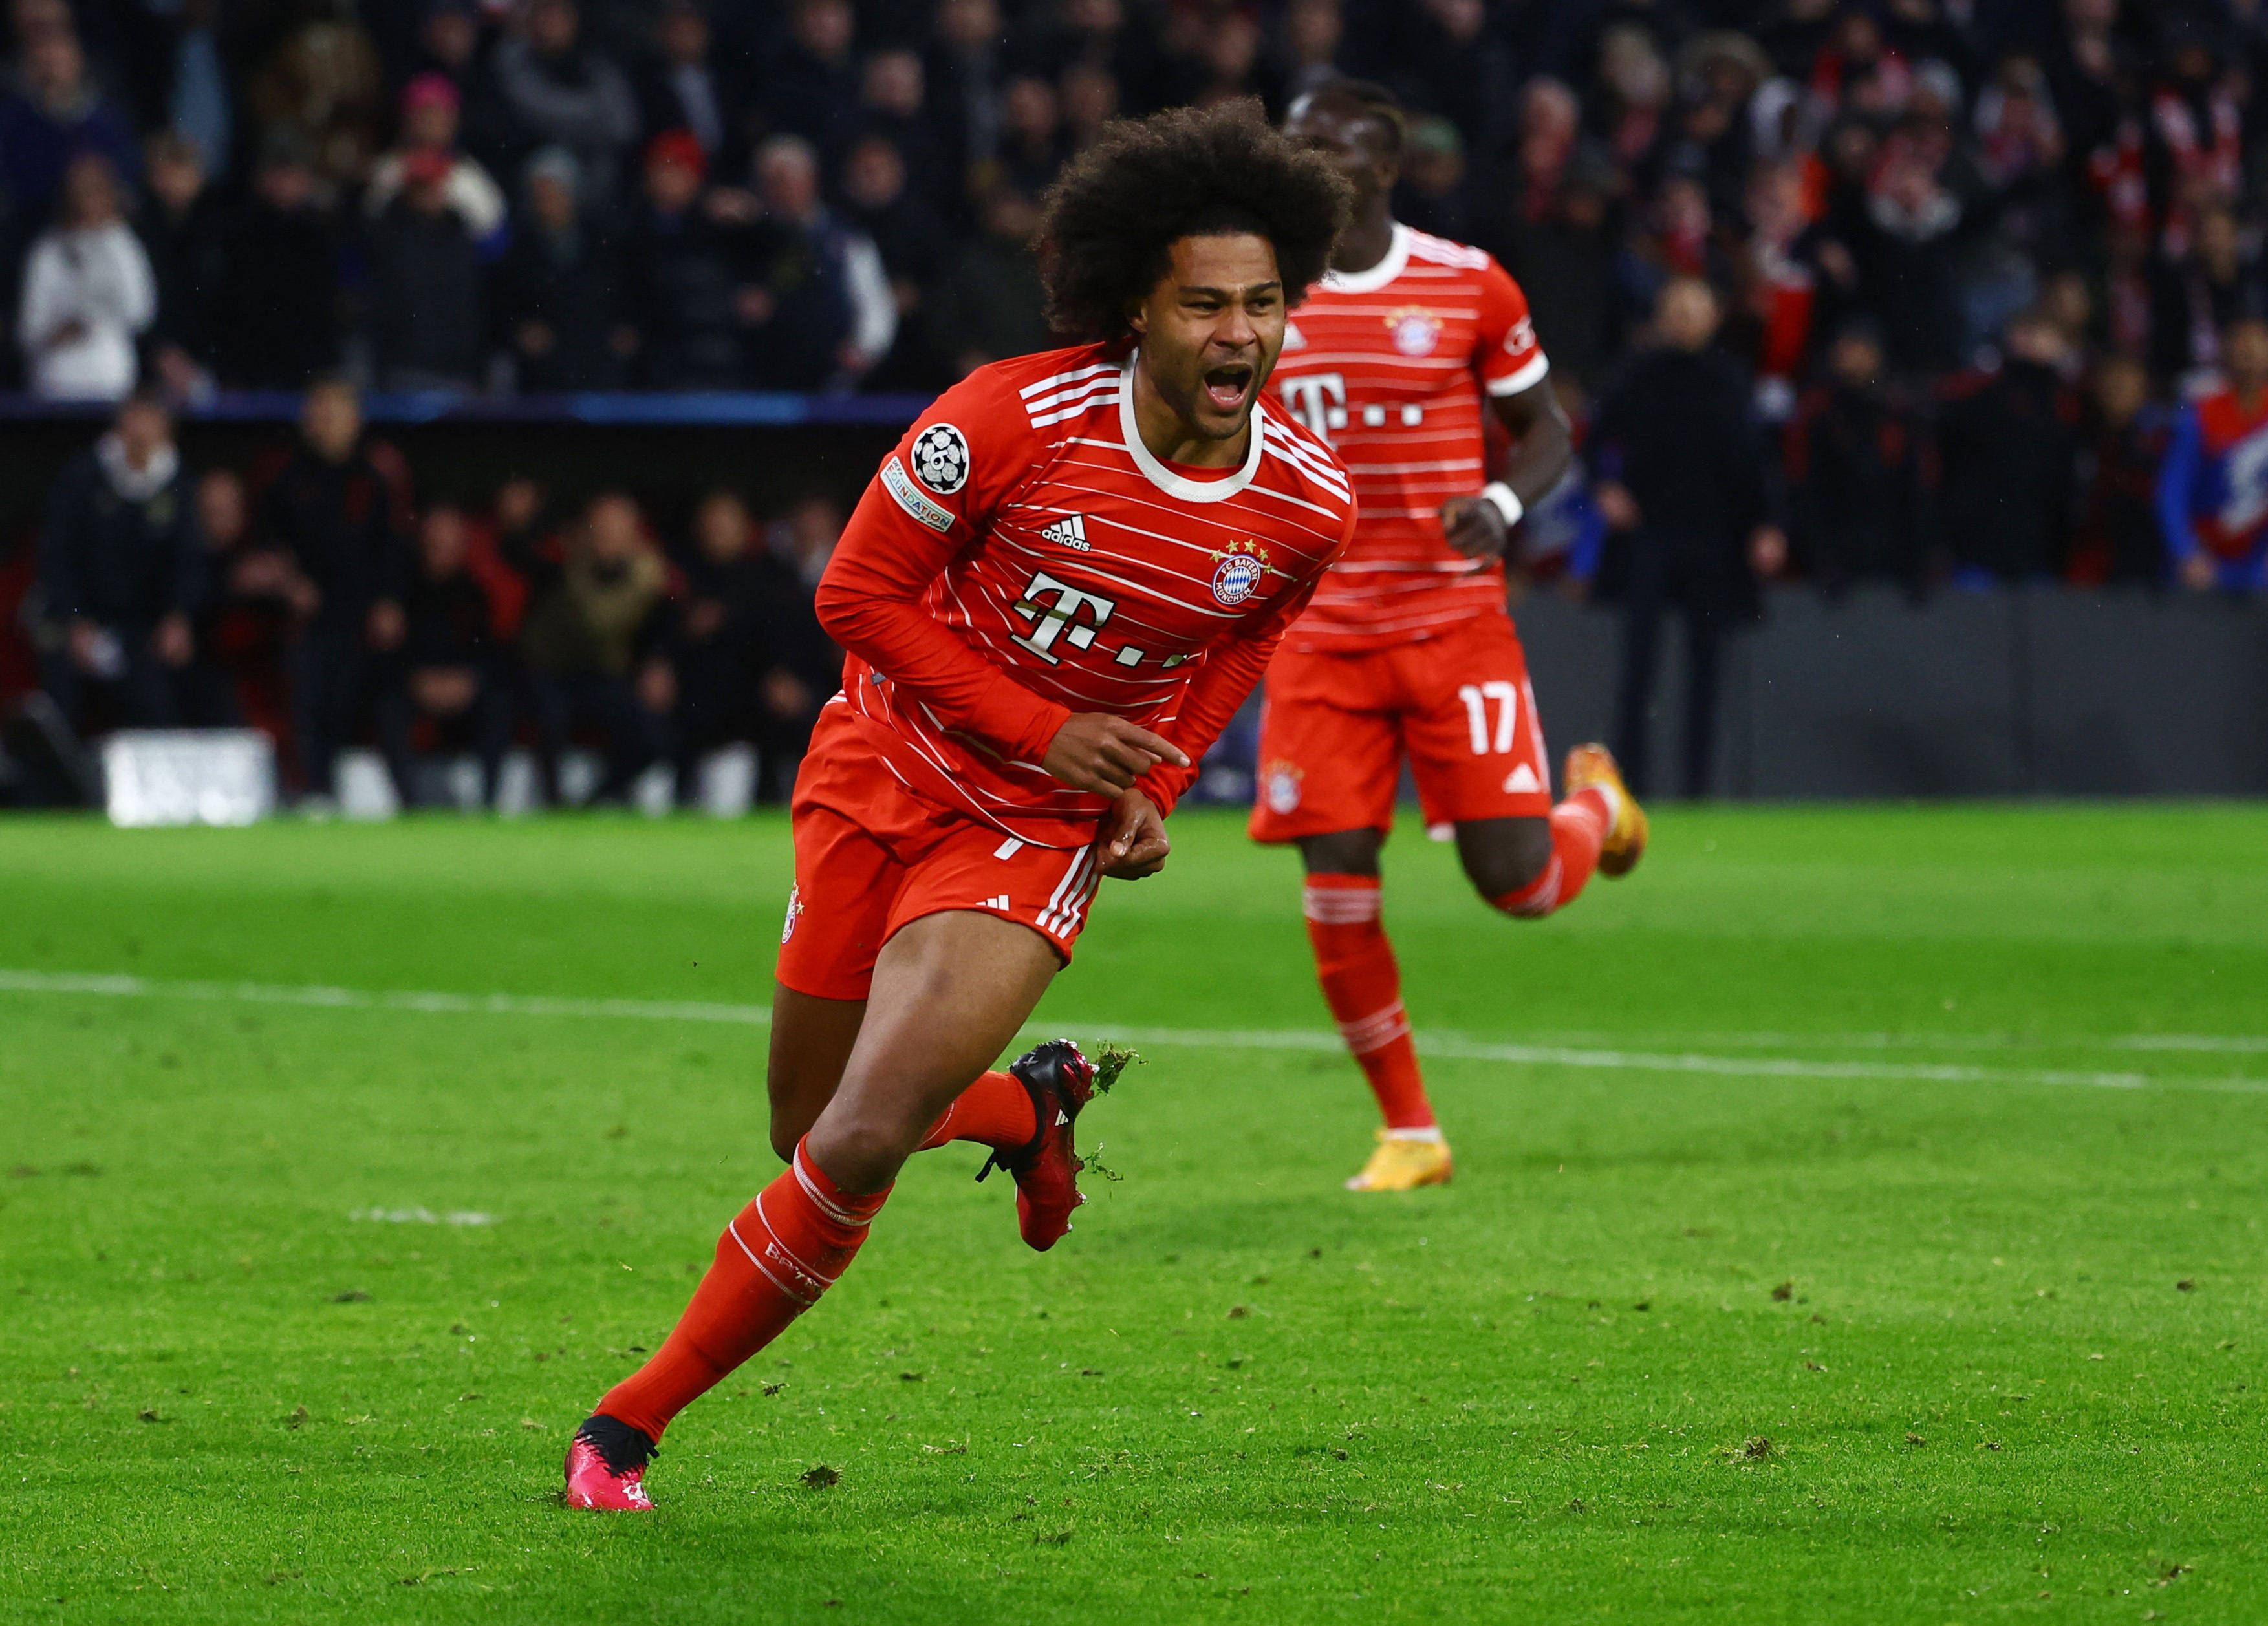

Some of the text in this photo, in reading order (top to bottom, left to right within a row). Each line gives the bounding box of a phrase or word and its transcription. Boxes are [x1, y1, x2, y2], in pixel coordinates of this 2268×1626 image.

[892, 460, 903, 476] UEFA
[1042, 529, 1090, 551] adidas
[1221, 559, 1258, 580] FC BAYERN
[1458, 680, 1517, 755] 17
